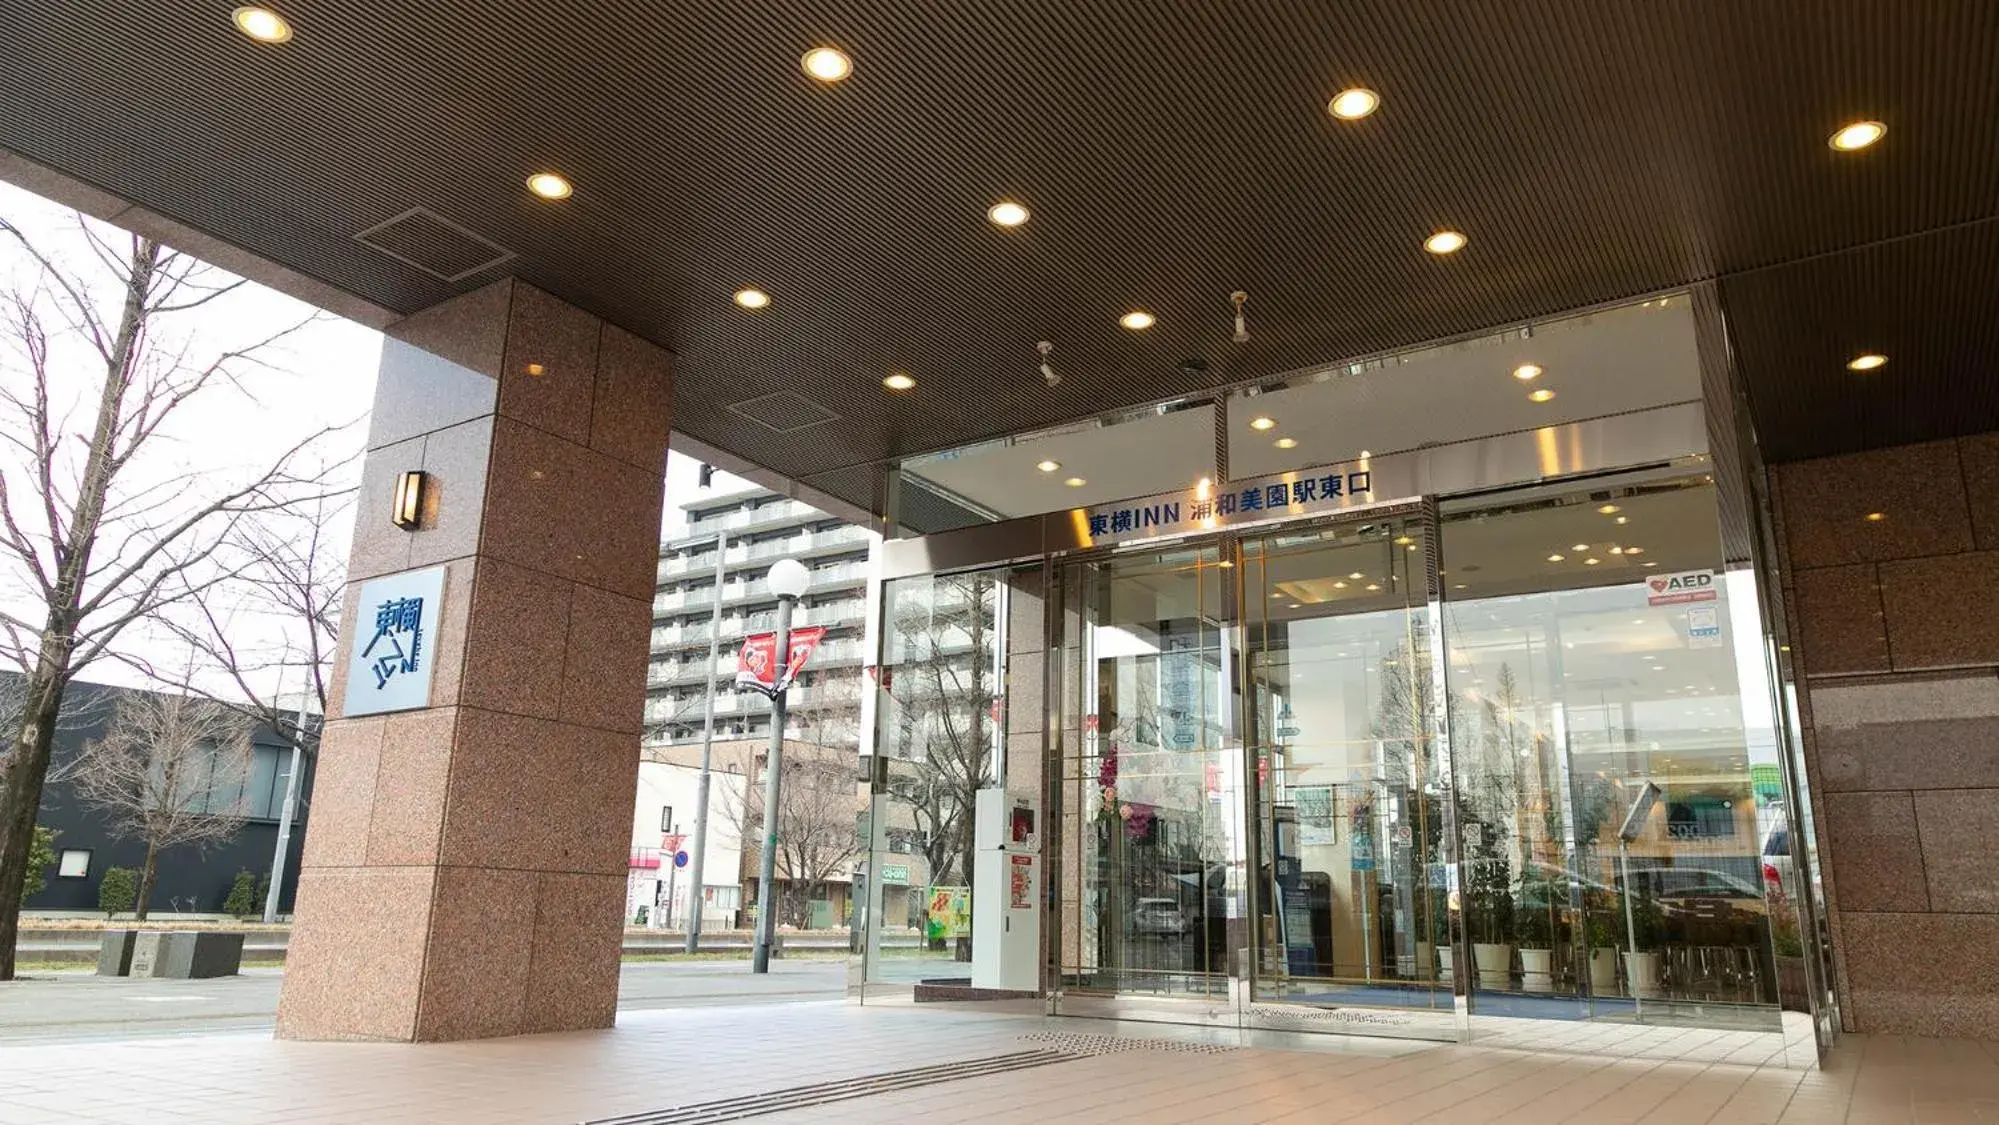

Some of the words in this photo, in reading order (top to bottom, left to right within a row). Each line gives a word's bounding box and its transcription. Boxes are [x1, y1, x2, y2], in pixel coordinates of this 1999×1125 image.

[1089, 502, 1180, 537] 東横INN
[1190, 471, 1371, 521] 浦和美園駅東口
[1669, 574, 1712, 590] AED
